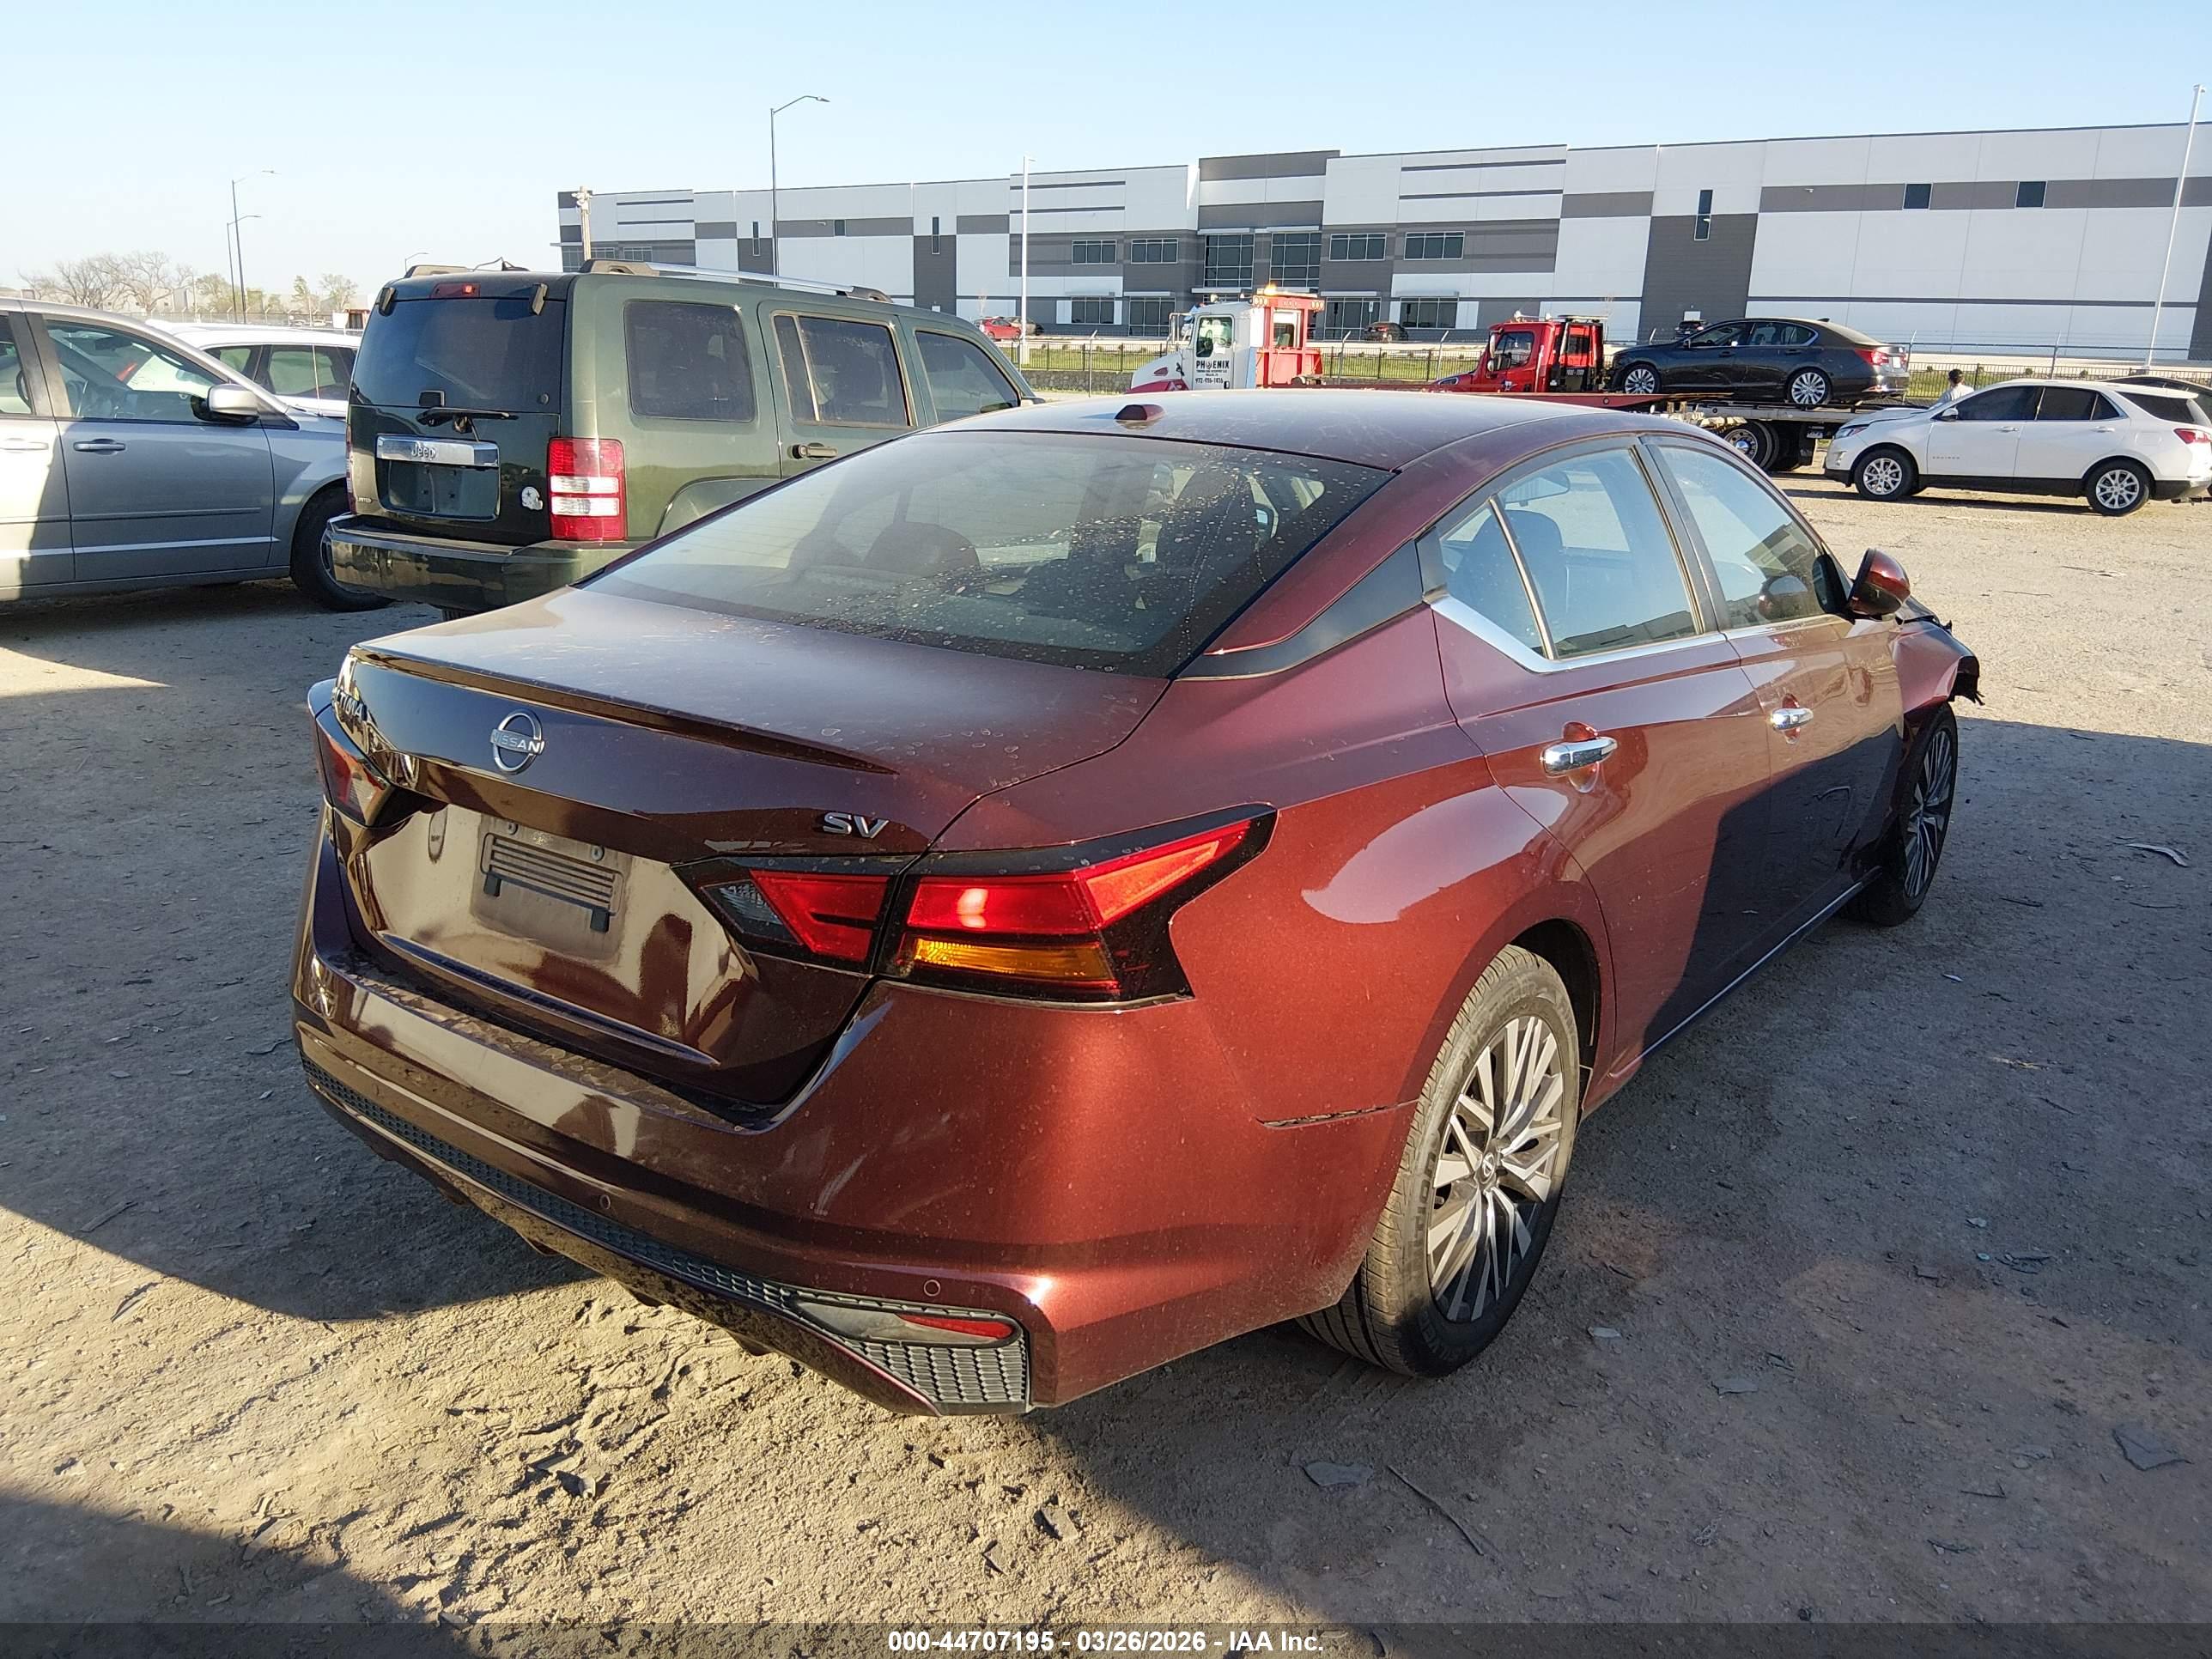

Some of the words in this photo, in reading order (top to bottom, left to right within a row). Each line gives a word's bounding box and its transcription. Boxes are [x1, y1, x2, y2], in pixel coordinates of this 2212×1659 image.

[411, 441, 438, 460] Jeep
[491, 731, 541, 753] NISSAN
[823, 811, 890, 839] SV
